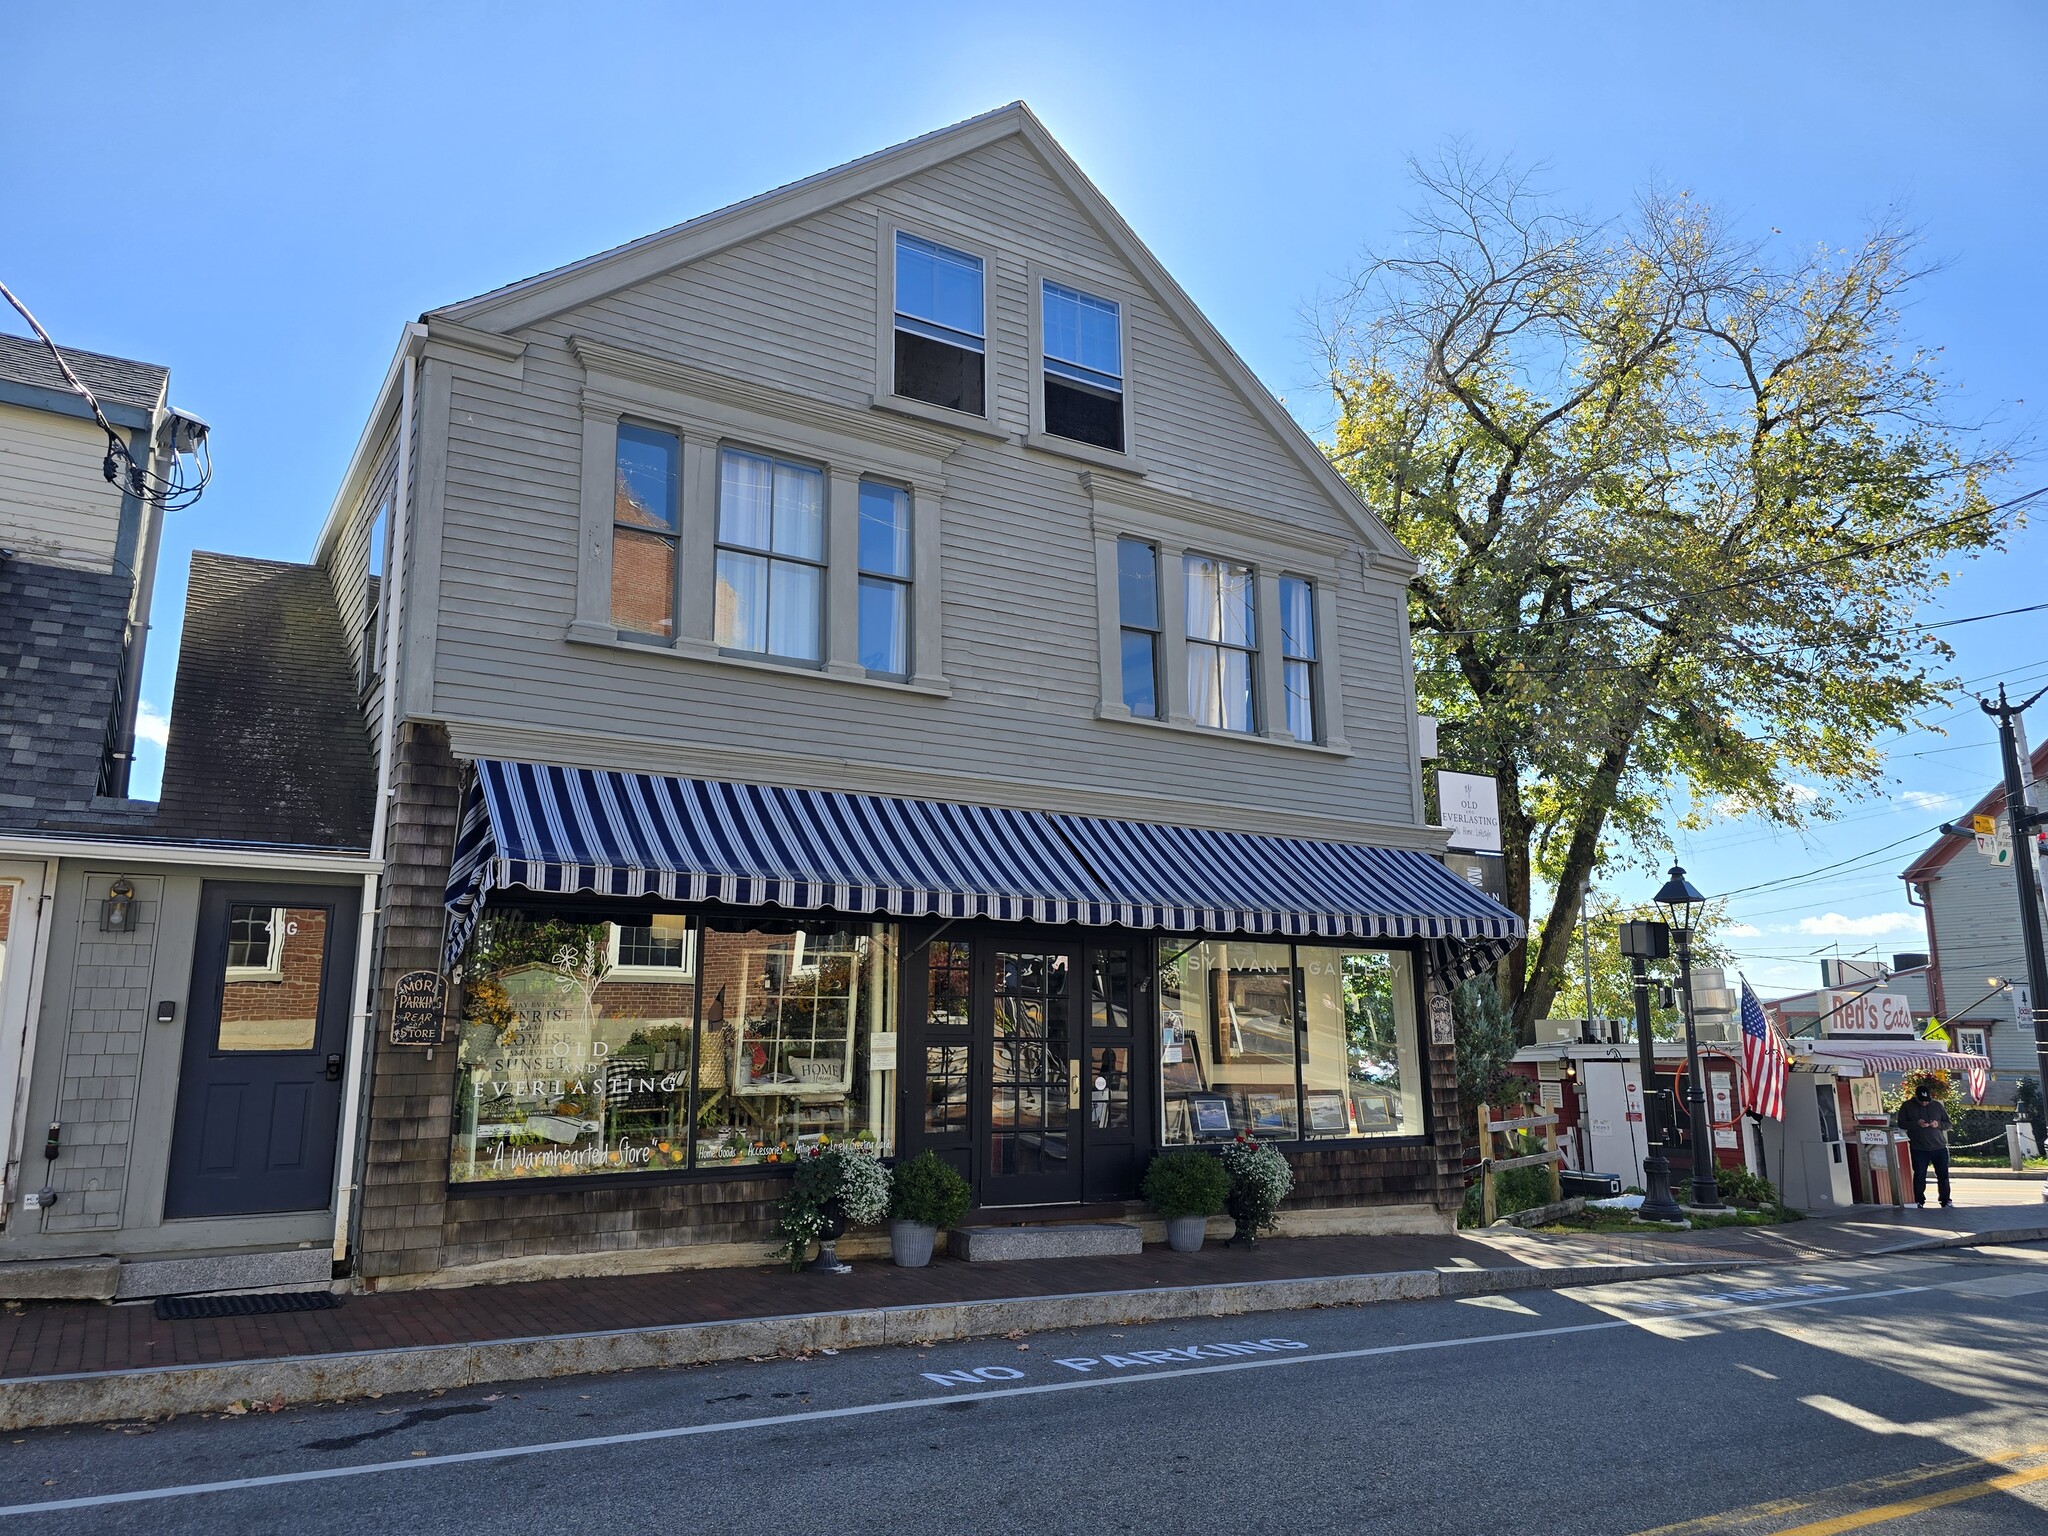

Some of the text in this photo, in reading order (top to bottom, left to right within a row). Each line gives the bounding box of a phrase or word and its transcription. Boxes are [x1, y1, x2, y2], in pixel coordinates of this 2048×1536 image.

[1461, 800, 1478, 810] OLD
[1442, 812, 1498, 827] EVERLASTING
[1188, 955, 1402, 978] SYLVAN GALLERY
[403, 1011, 433, 1021] REAR
[517, 1009, 573, 1023] NRISE
[1832, 995, 1911, 1031] Red's Eats
[399, 1026, 436, 1039] STORE
[553, 1041, 609, 1057] OLD
[495, 1056, 566, 1072] SUNSET
[562, 1063, 597, 1074] AND
[801, 1063, 839, 1077] HOME
[472, 1077, 677, 1098] EVERLASTING
[511, 1142, 609, 1170] Warmhearted
[698, 1147, 717, 1159] Home
[718, 1146, 736, 1158] Goods
[748, 1143, 783, 1156] Accessories
[919, 1337, 1309, 1387] NO PARKING
